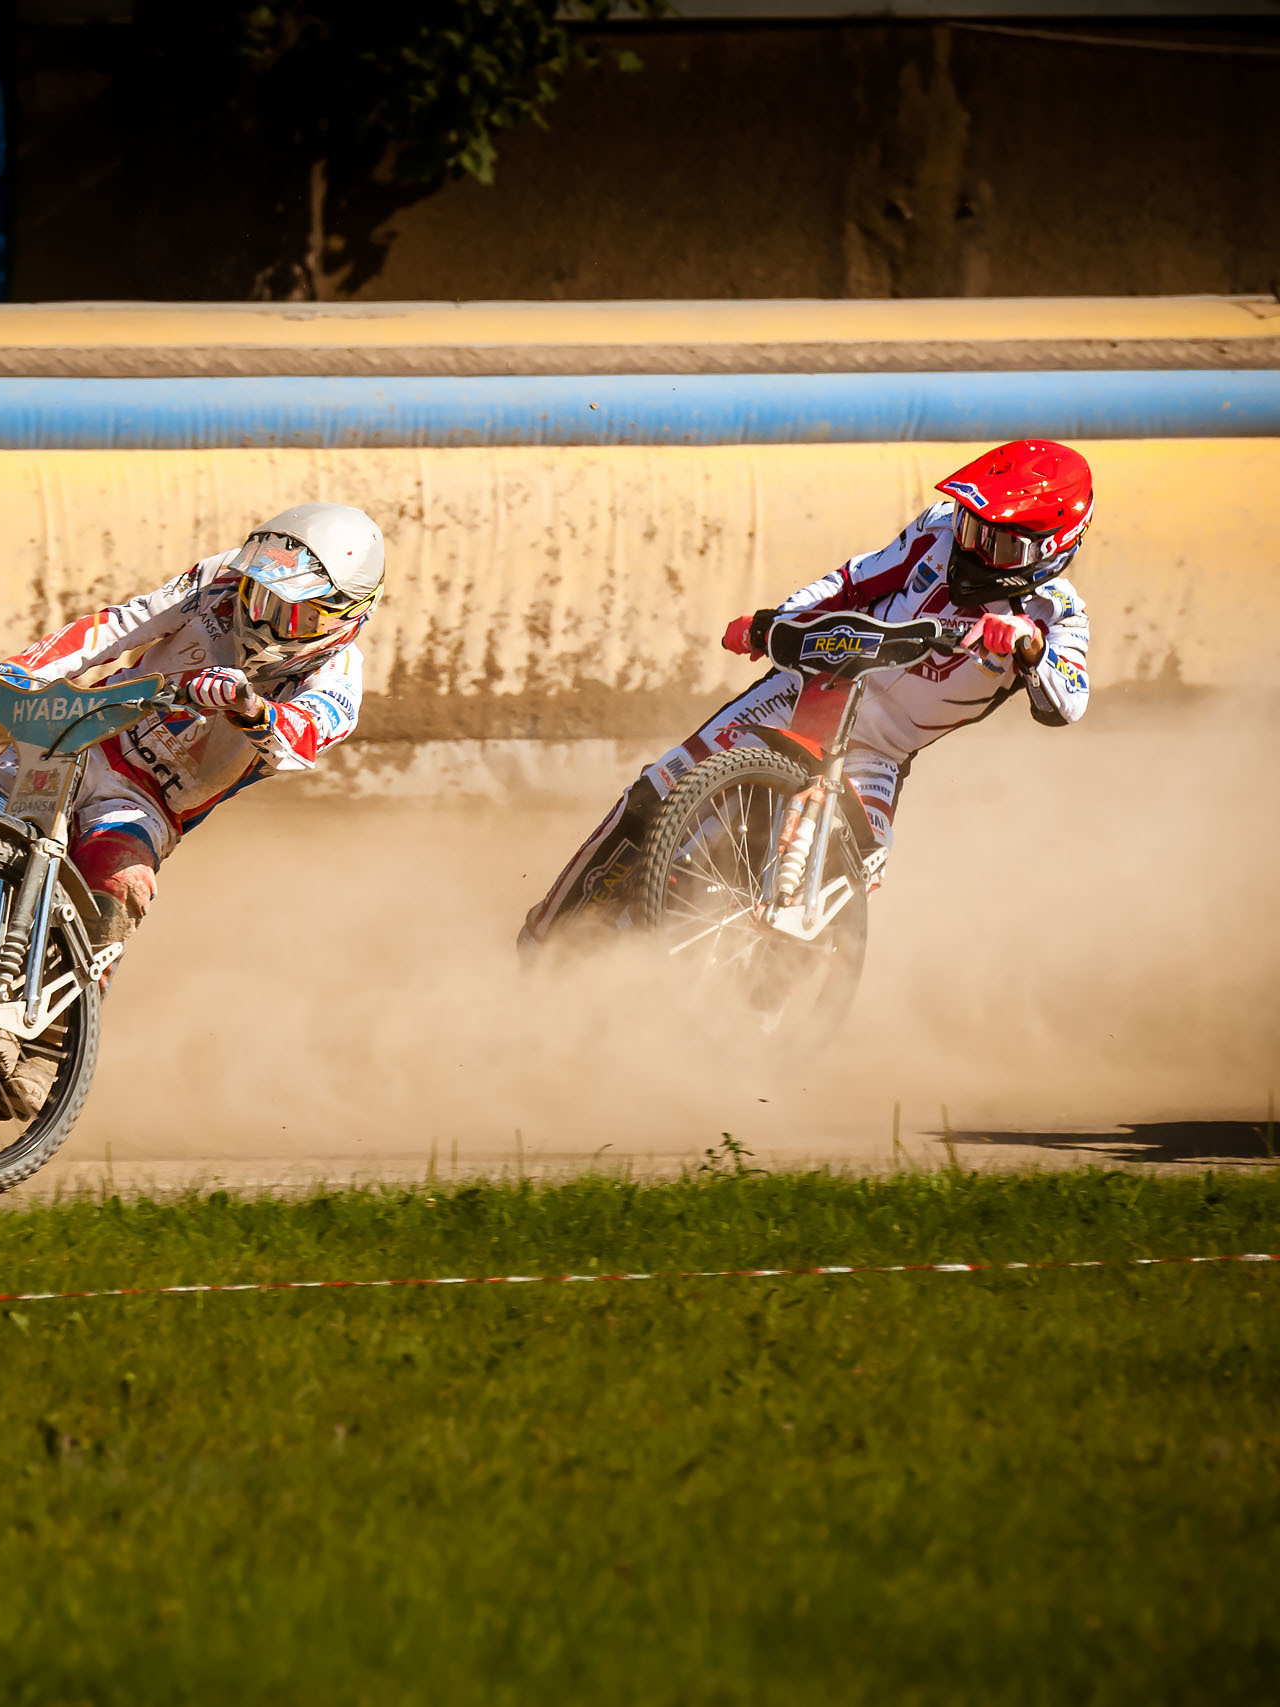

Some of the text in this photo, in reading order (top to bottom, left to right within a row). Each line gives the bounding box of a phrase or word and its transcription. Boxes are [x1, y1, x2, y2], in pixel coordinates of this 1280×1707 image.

[178, 641, 207, 666] 19
[814, 637, 864, 652] REALL
[13, 697, 108, 723] HYABAK
